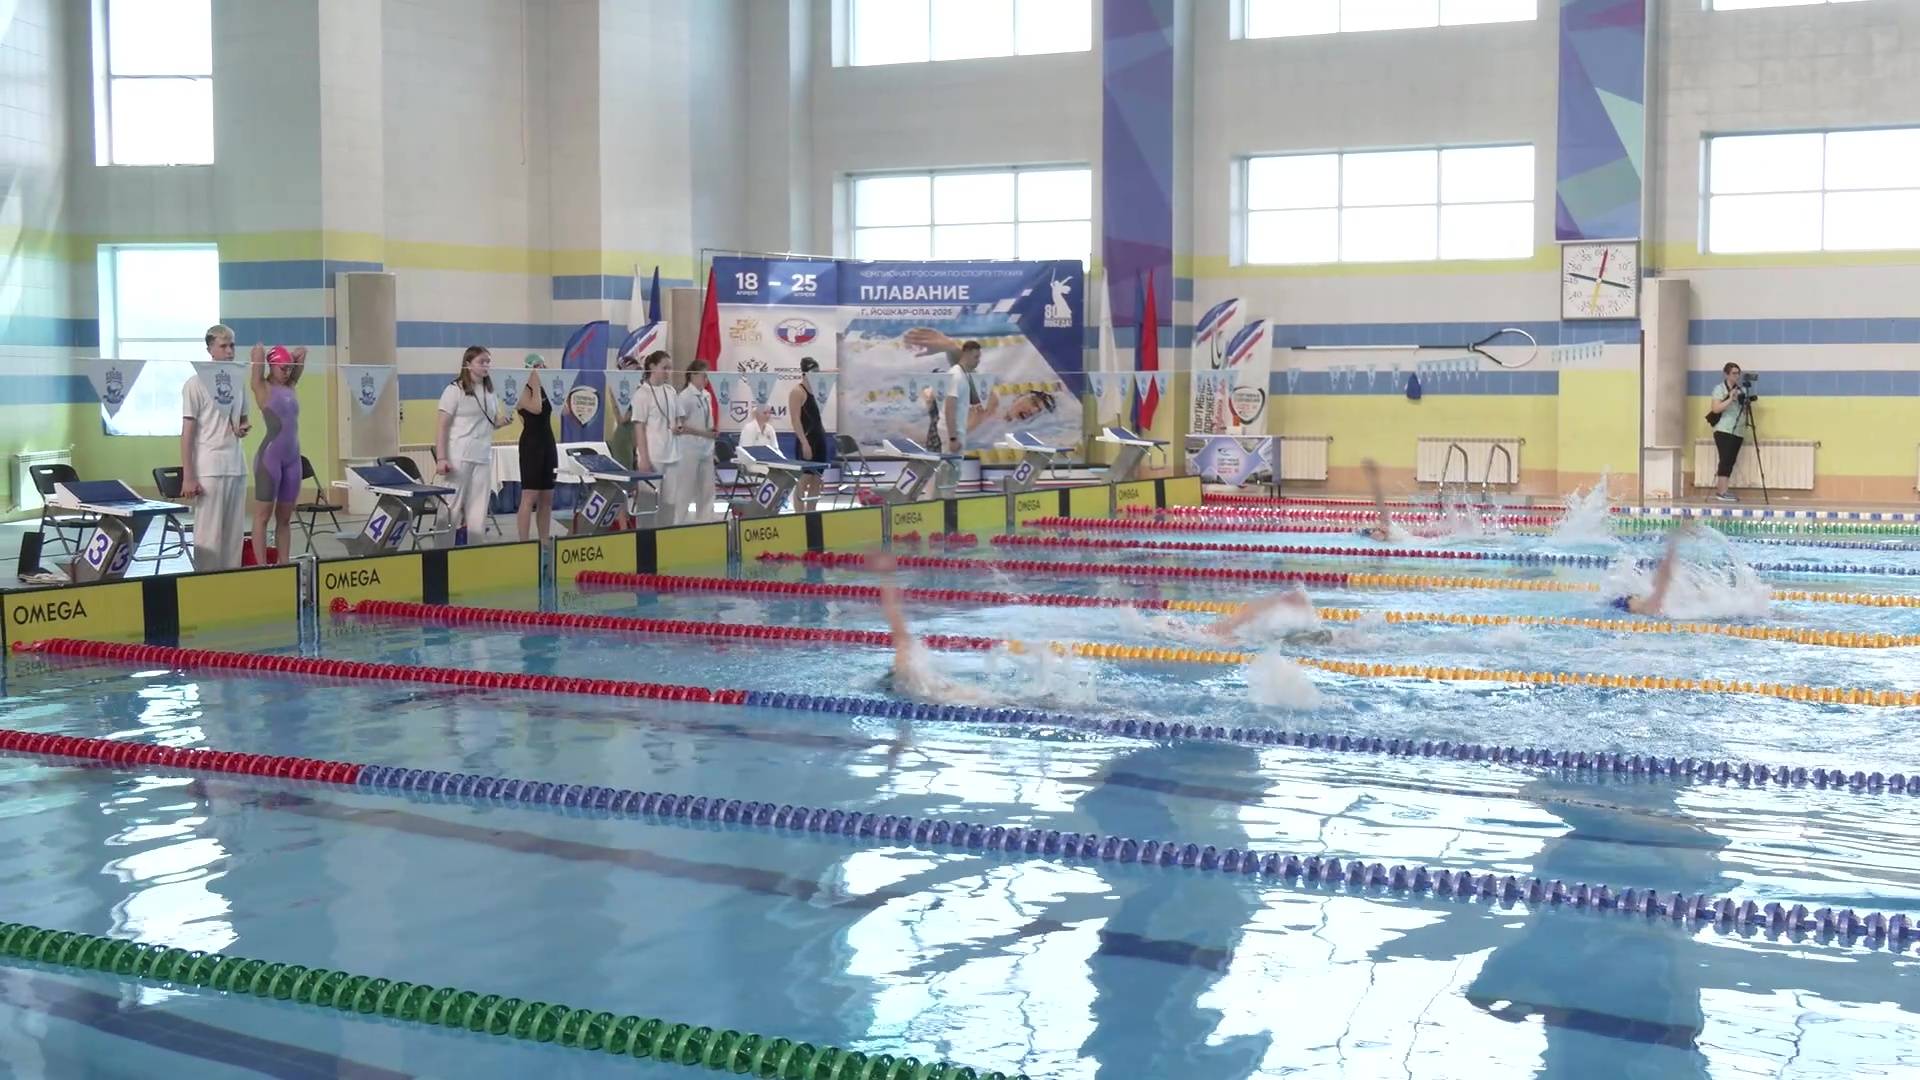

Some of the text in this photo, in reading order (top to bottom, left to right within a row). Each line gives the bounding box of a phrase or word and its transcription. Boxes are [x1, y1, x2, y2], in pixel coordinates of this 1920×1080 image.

[735, 272, 758, 290] 18
[791, 273, 817, 292] 25
[860, 285, 970, 300] ПЛАВАНИЕ
[900, 470, 917, 490] 7
[1016, 463, 1031, 481] 8
[759, 483, 775, 504] 6
[586, 494, 605, 519] 5
[369, 514, 388, 541] 4
[744, 526, 779, 542] OMEGA
[88, 533, 109, 566] 3
[561, 546, 604, 564] OMEGA
[325, 567, 381, 590] OMEGA
[13, 599, 87, 625] OMEGA
